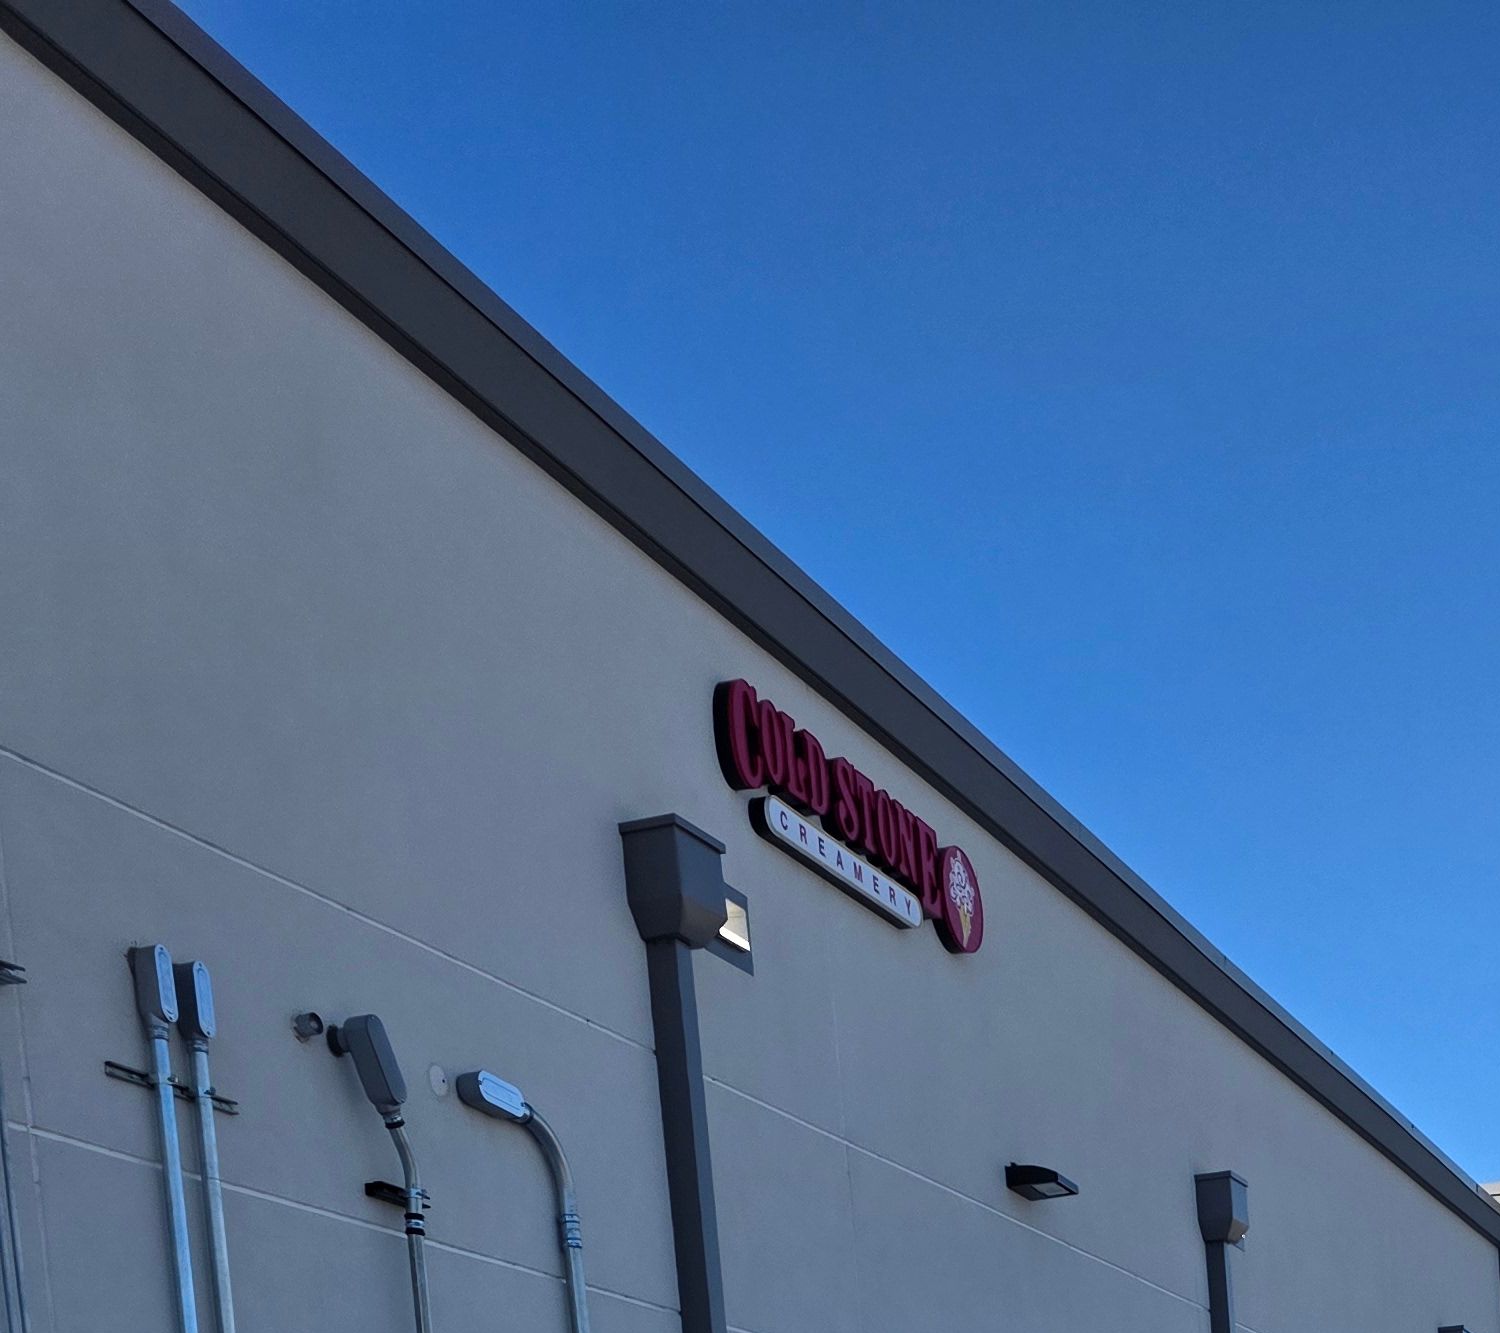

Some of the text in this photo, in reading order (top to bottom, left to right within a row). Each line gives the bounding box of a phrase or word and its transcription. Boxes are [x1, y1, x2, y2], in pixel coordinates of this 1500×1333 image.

[722, 678, 942, 920] COLD STONE
[779, 811, 913, 916] CREAMERY
